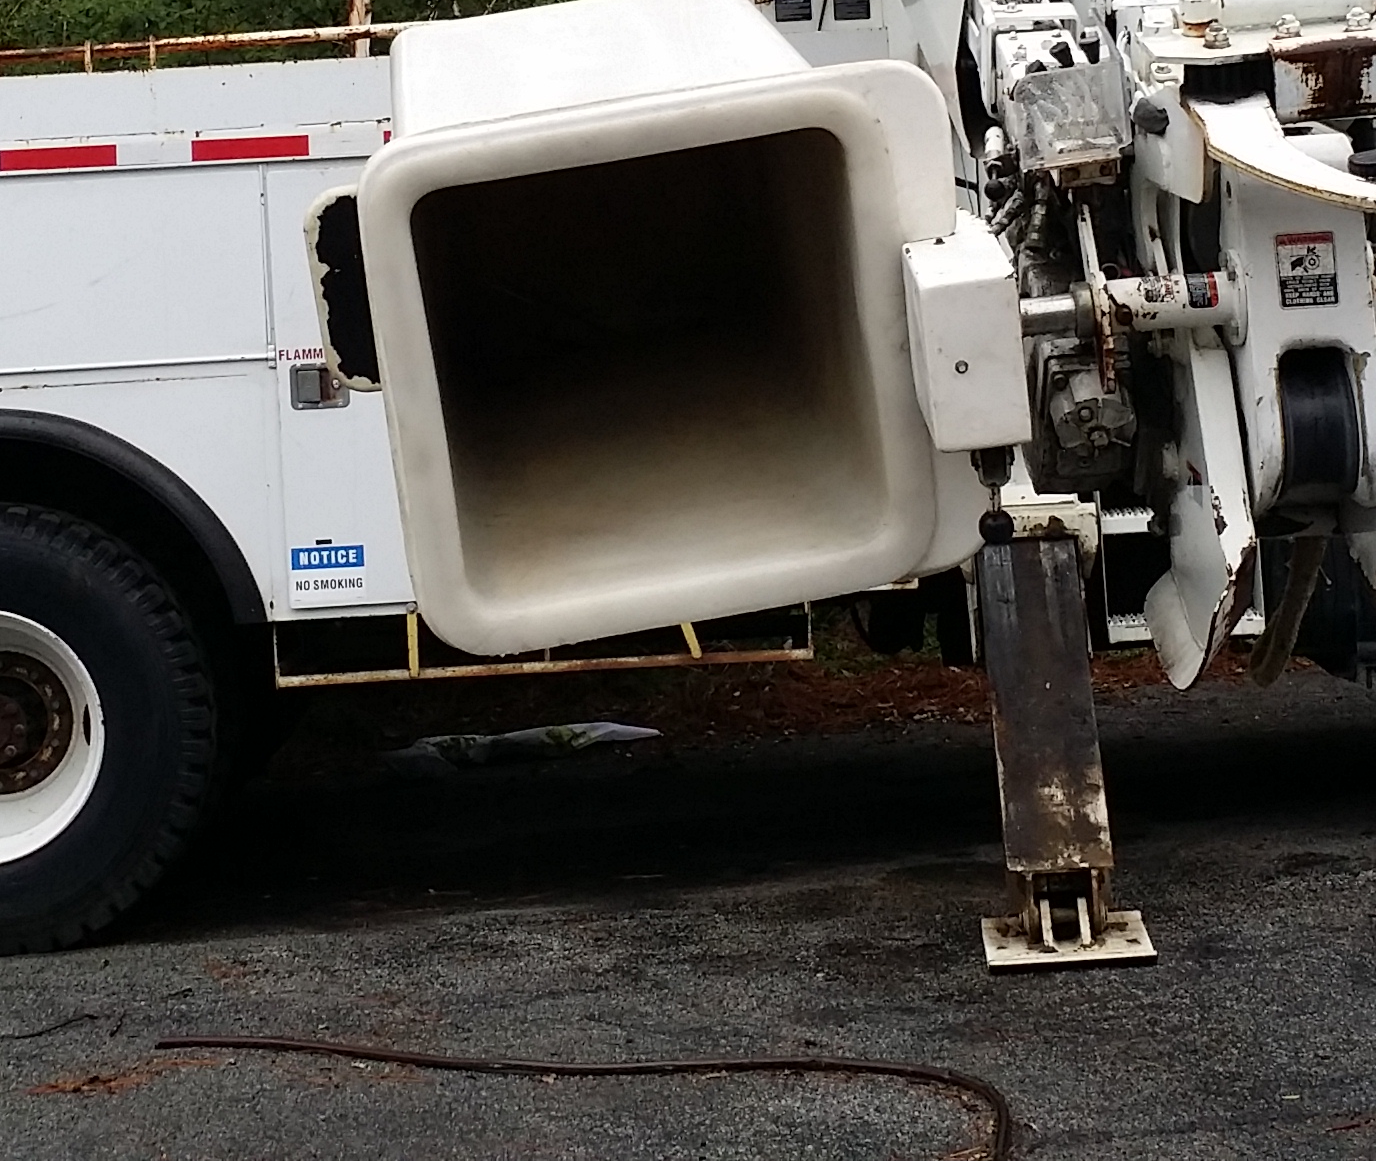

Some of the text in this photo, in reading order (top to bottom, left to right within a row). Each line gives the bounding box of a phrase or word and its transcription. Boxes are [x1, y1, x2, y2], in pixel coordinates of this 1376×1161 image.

[299, 549, 357, 566] NOTICE
[295, 577, 363, 591] NO SMOKING
